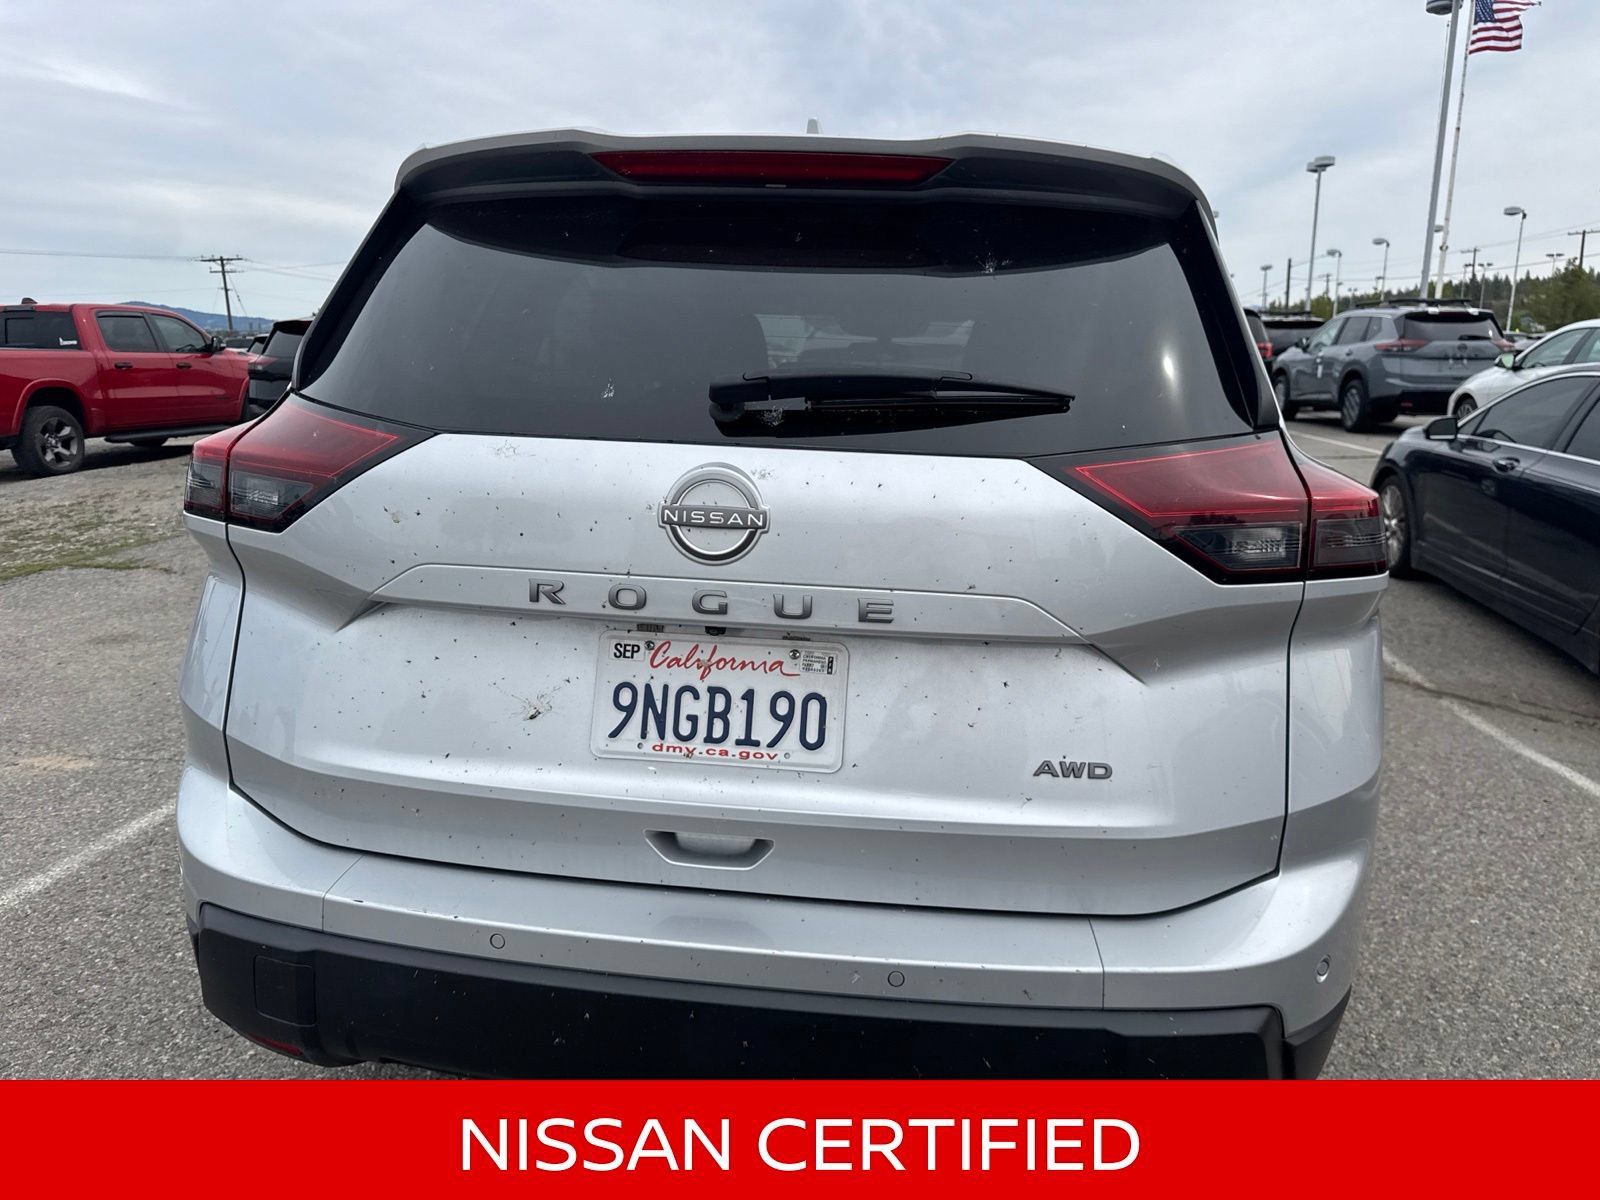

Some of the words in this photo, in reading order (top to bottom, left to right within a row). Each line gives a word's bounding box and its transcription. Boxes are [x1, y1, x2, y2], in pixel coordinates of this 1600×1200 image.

[664, 509, 763, 526] NISSAN
[528, 578, 895, 623] ROGUE
[613, 642, 641, 659] SEP
[650, 640, 800, 682] California
[608, 681, 828, 751] 9NGB190
[651, 743, 779, 761] dmv.ca.gov
[1032, 760, 1113, 780] AWD
